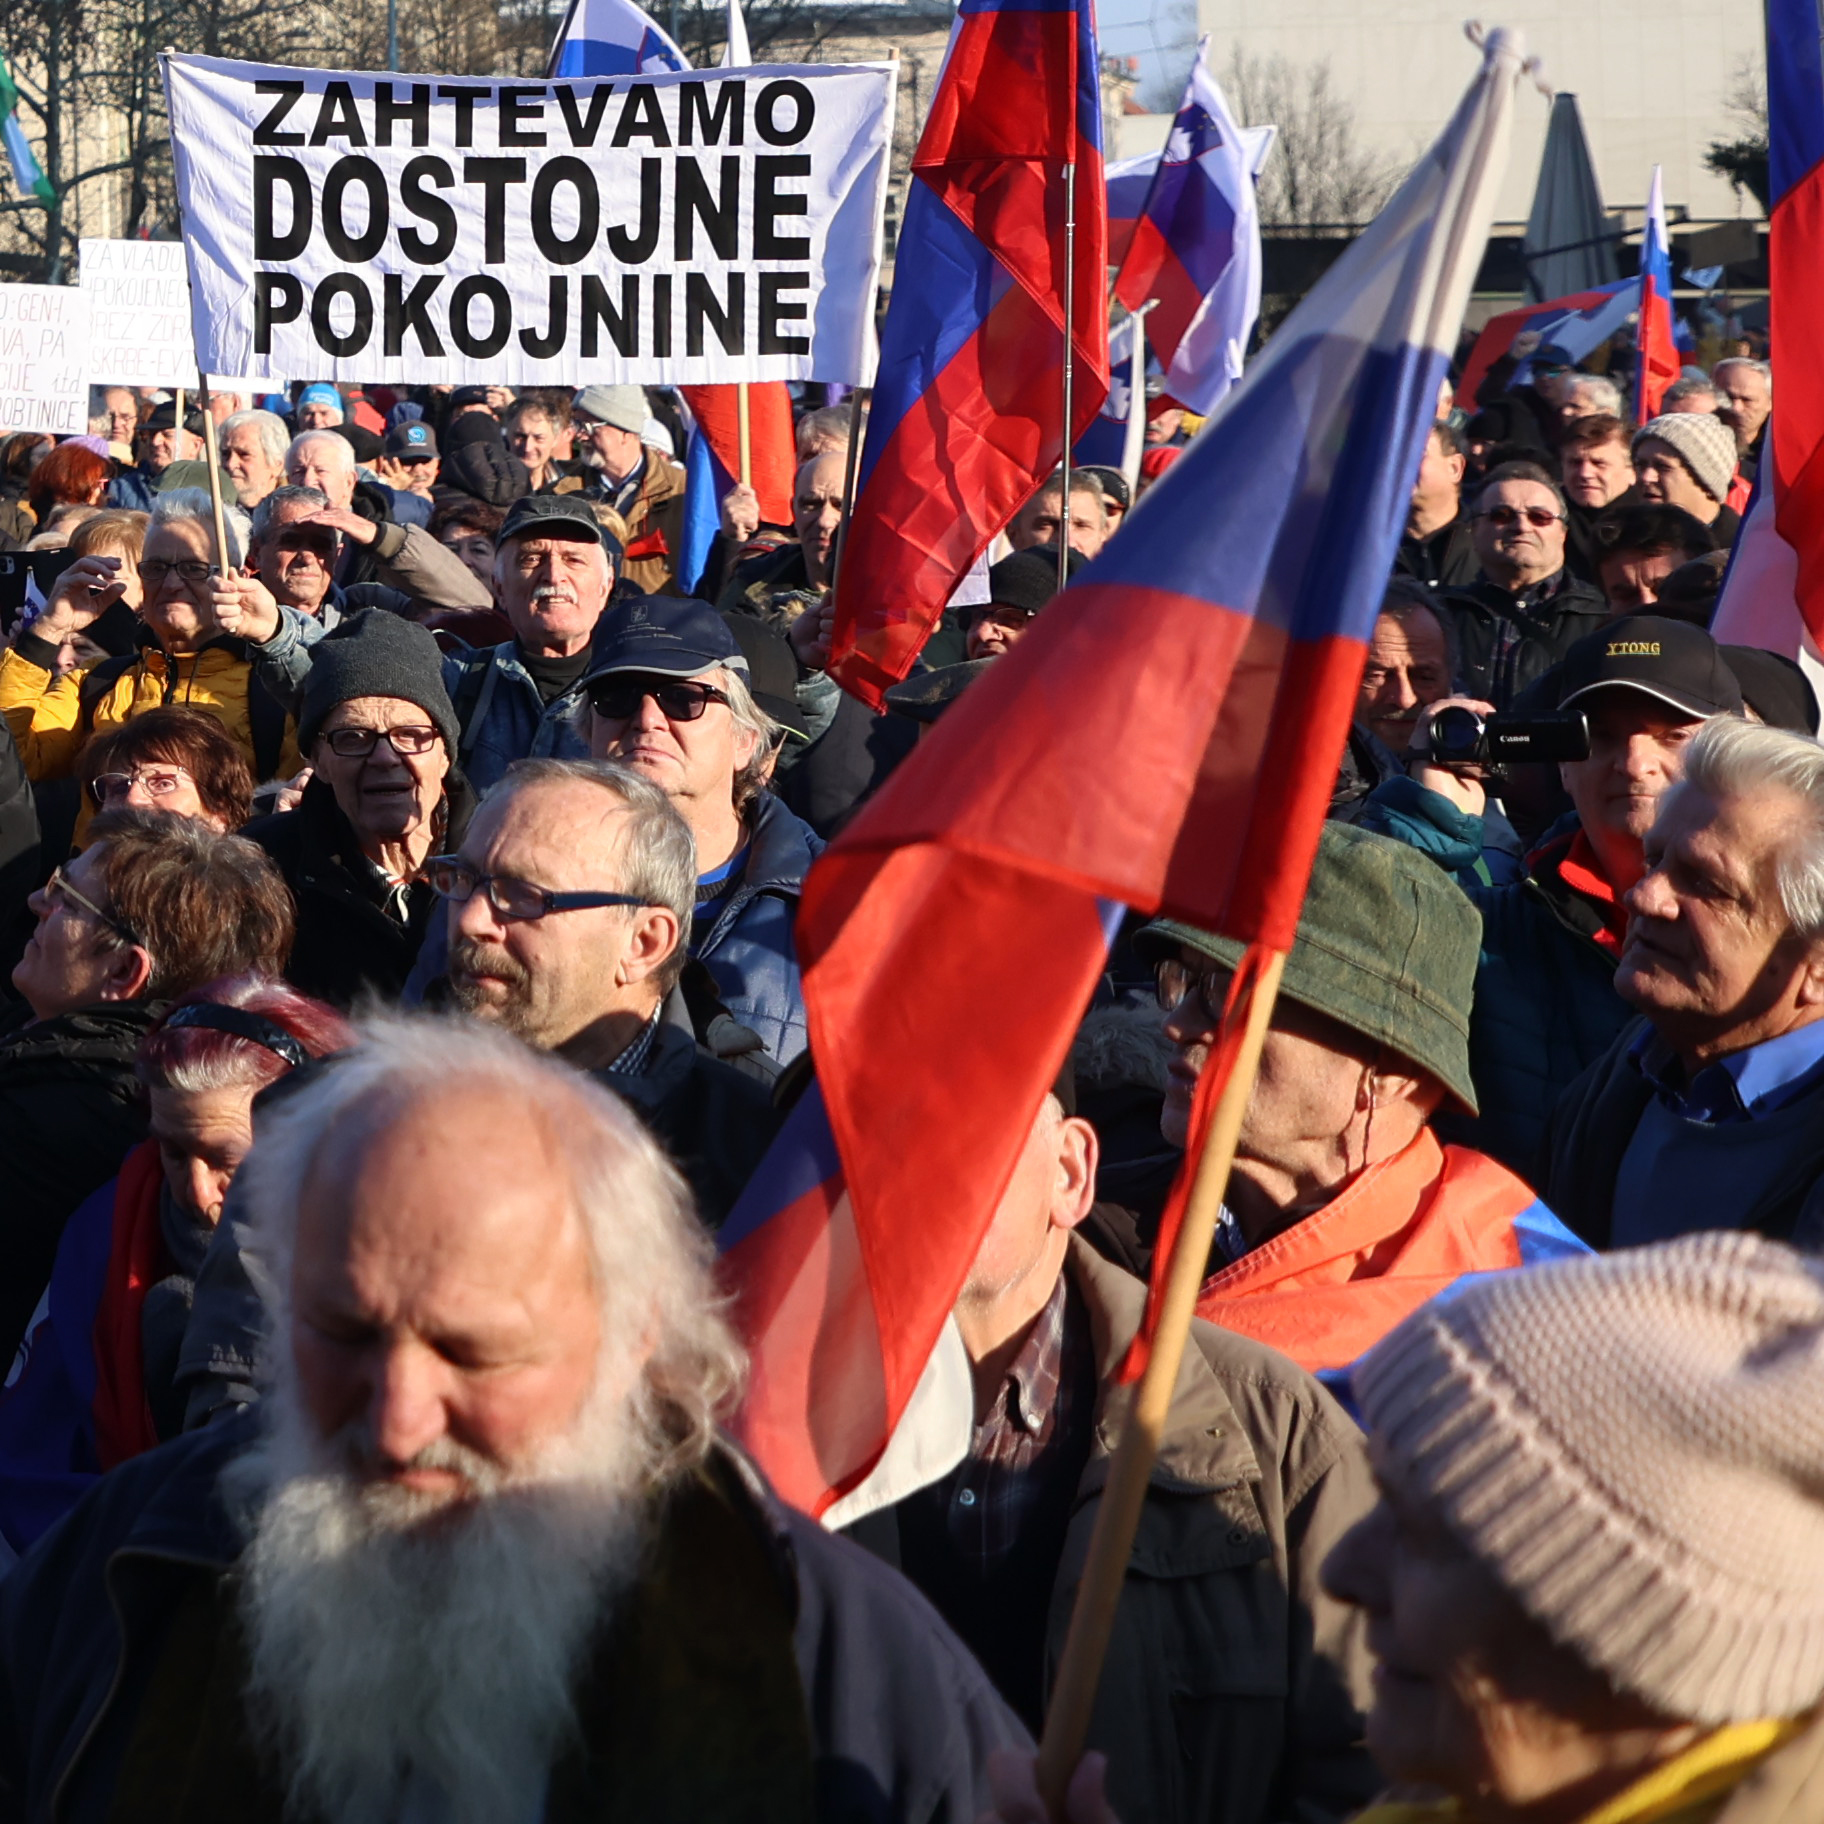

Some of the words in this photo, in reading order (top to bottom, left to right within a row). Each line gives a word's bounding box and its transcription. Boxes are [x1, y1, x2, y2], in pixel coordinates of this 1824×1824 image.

[252, 78, 816, 149] ZAHTEVAMO
[253, 153, 813, 266] DOSTOJNE
[82, 241, 113, 271] ZA
[122, 243, 183, 273] VLADO
[253, 270, 812, 360] POKOJNINE
[38, 328, 65, 358] PA
[90, 344, 196, 378] SKRBE-EVT
[1499, 735, 1530, 743] Canon
